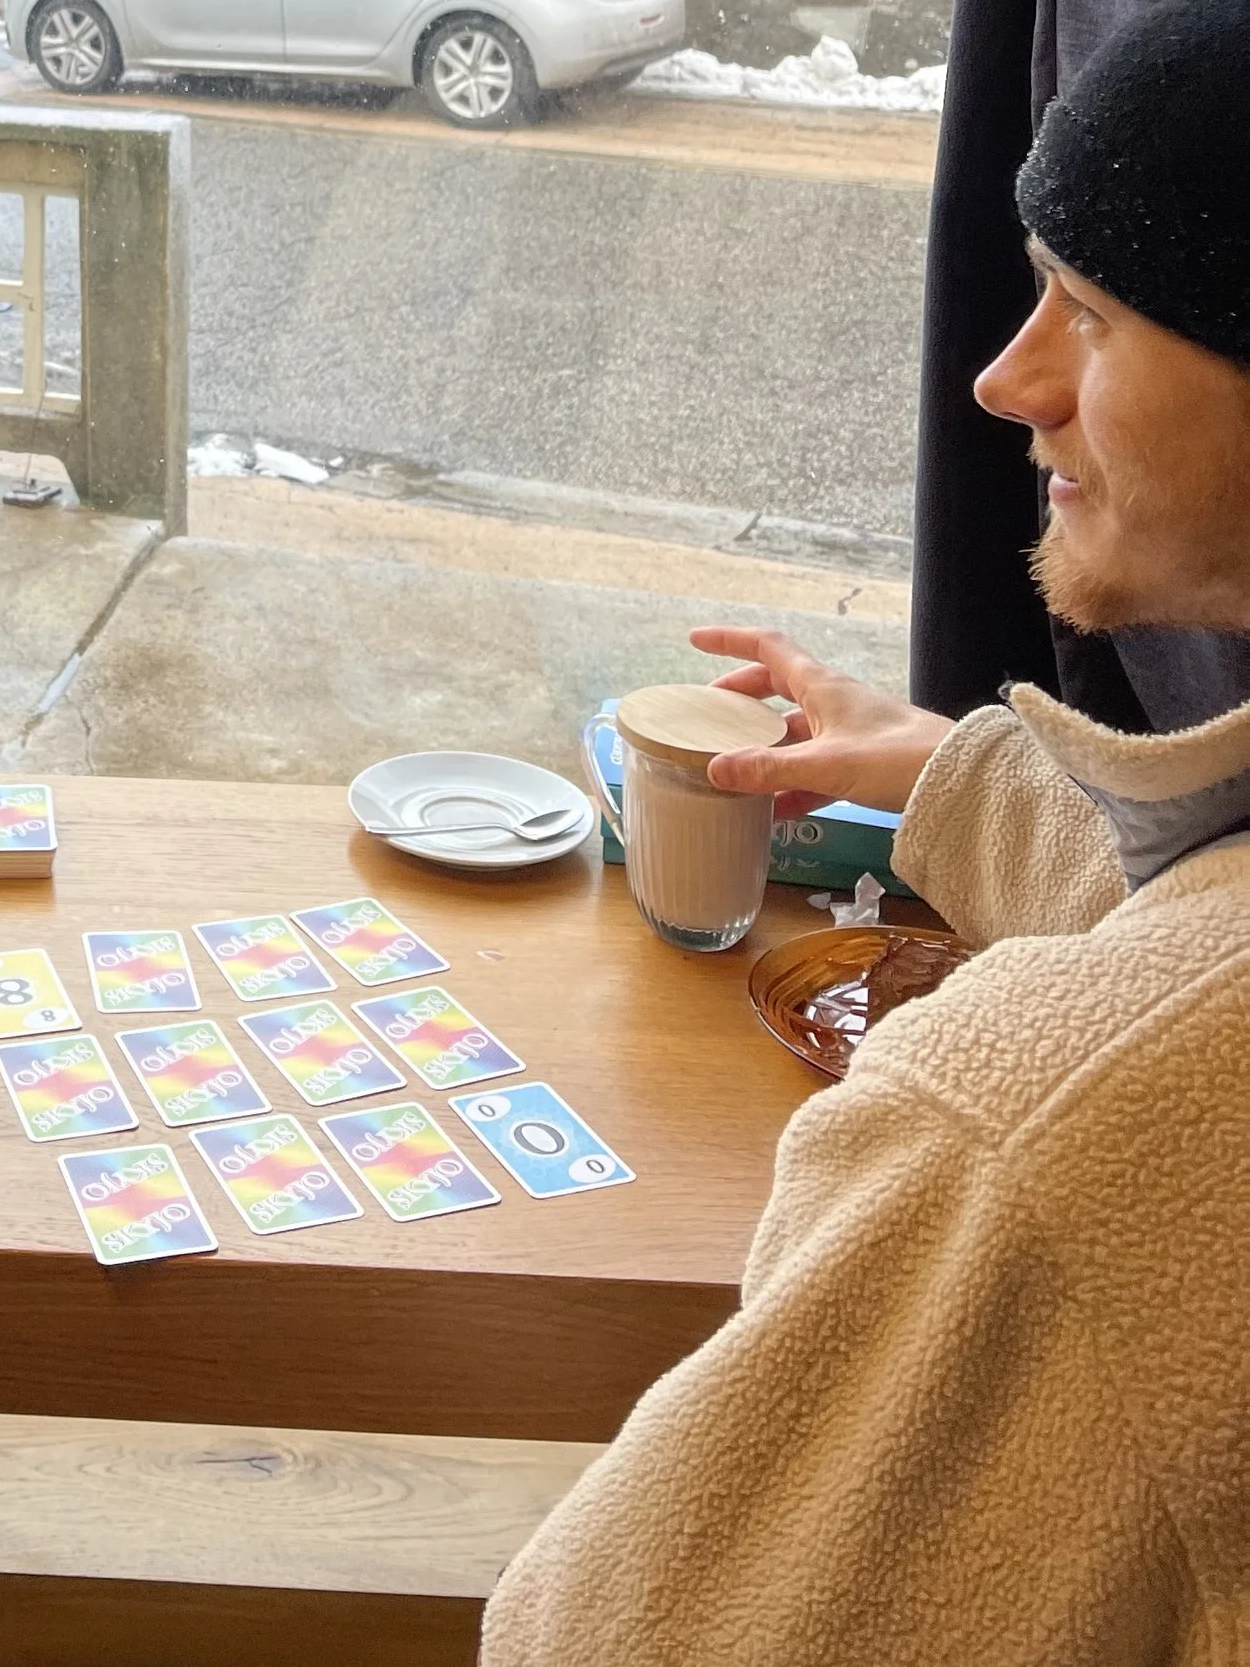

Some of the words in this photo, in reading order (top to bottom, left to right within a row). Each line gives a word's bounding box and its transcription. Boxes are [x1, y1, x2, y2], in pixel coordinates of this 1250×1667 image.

[218, 922, 286, 957] SKYJO
[324, 906, 381, 945] SKYJO
[99, 937, 177, 967] SKYJO
[357, 939, 417, 978] SKYJO
[106, 973, 186, 1007] SKYJO
[242, 957, 311, 994] SKYJO
[40, 1010, 57, 1022] 8
[271, 1009, 338, 1054] SKYJO
[388, 995, 451, 1039] SKYJO
[15, 1044, 94, 1086] SKYJO
[143, 1029, 217, 1072] SKYJO
[425, 1034, 489, 1083] SKYJO
[305, 1049, 374, 1096] SKYJO
[34, 1087, 114, 1133] SKYJO
[167, 1072, 243, 1118] SKYJO
[478, 1104, 496, 1117] 0
[221, 1125, 298, 1173] SKYJO
[353, 1113, 428, 1161] SKYJO
[513, 1122, 565, 1155] 0
[83, 1154, 169, 1201] SKYJO
[389, 1159, 464, 1211] SKYJO
[586, 1159, 605, 1174] 0
[252, 1172, 330, 1223] SKYJO
[104, 1204, 191, 1254] SKYJO
